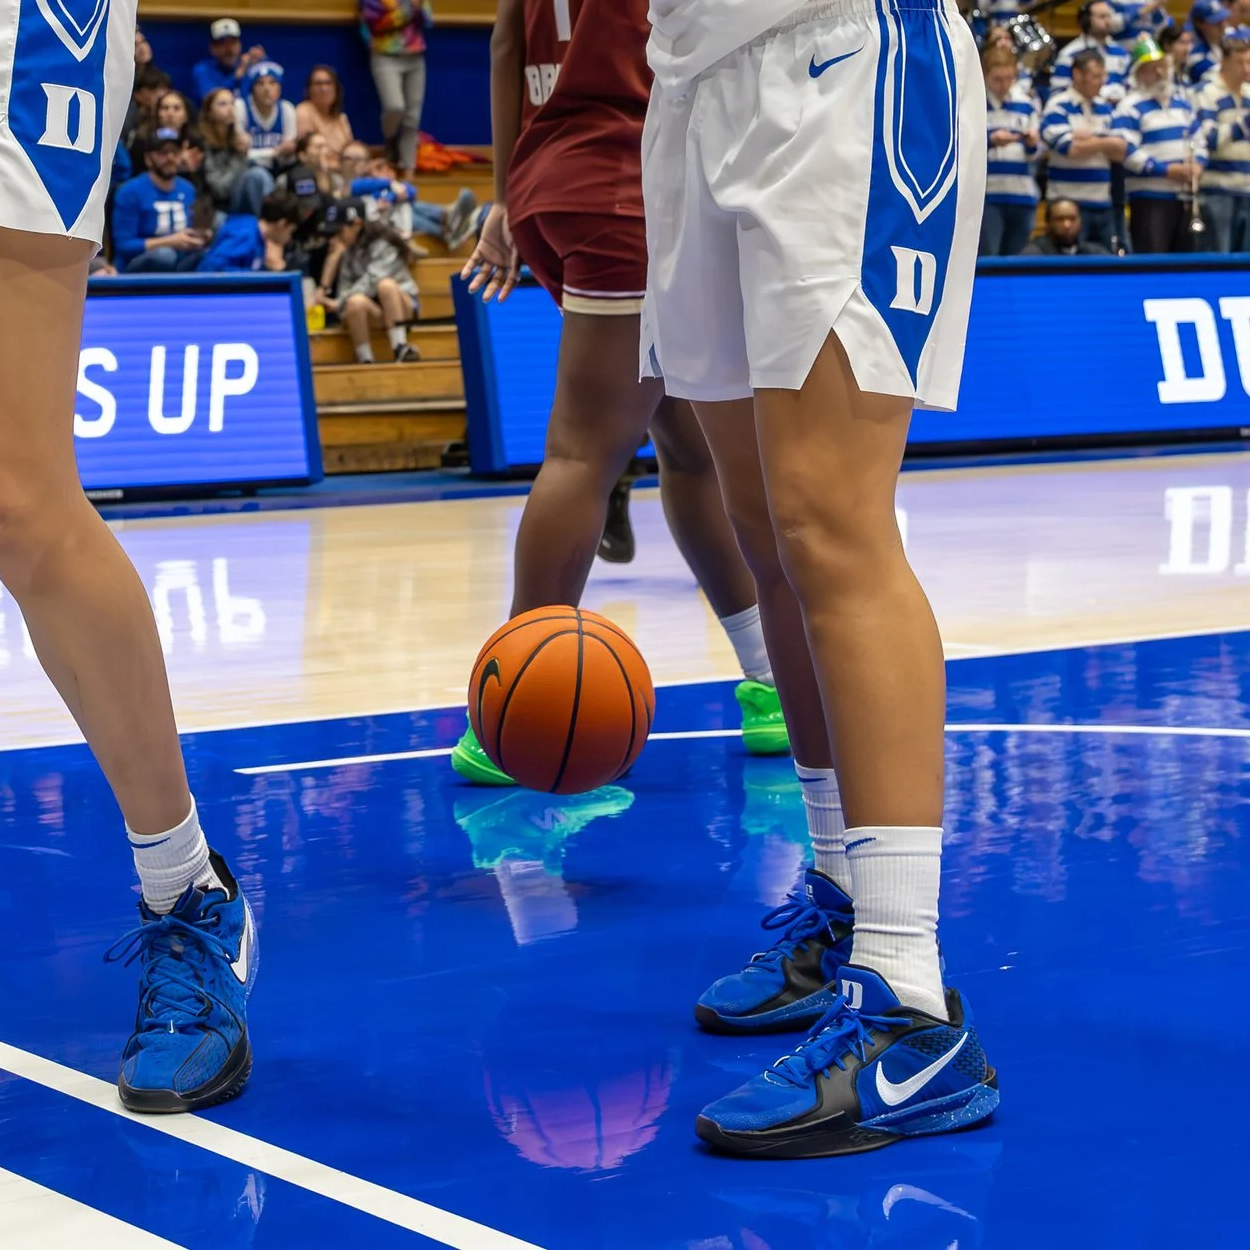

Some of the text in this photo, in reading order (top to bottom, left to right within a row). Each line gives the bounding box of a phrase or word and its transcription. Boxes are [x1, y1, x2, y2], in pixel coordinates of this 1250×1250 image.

[37, 83, 97, 154] D
[889, 245, 937, 316] D
[148, 342, 259, 435] UP
